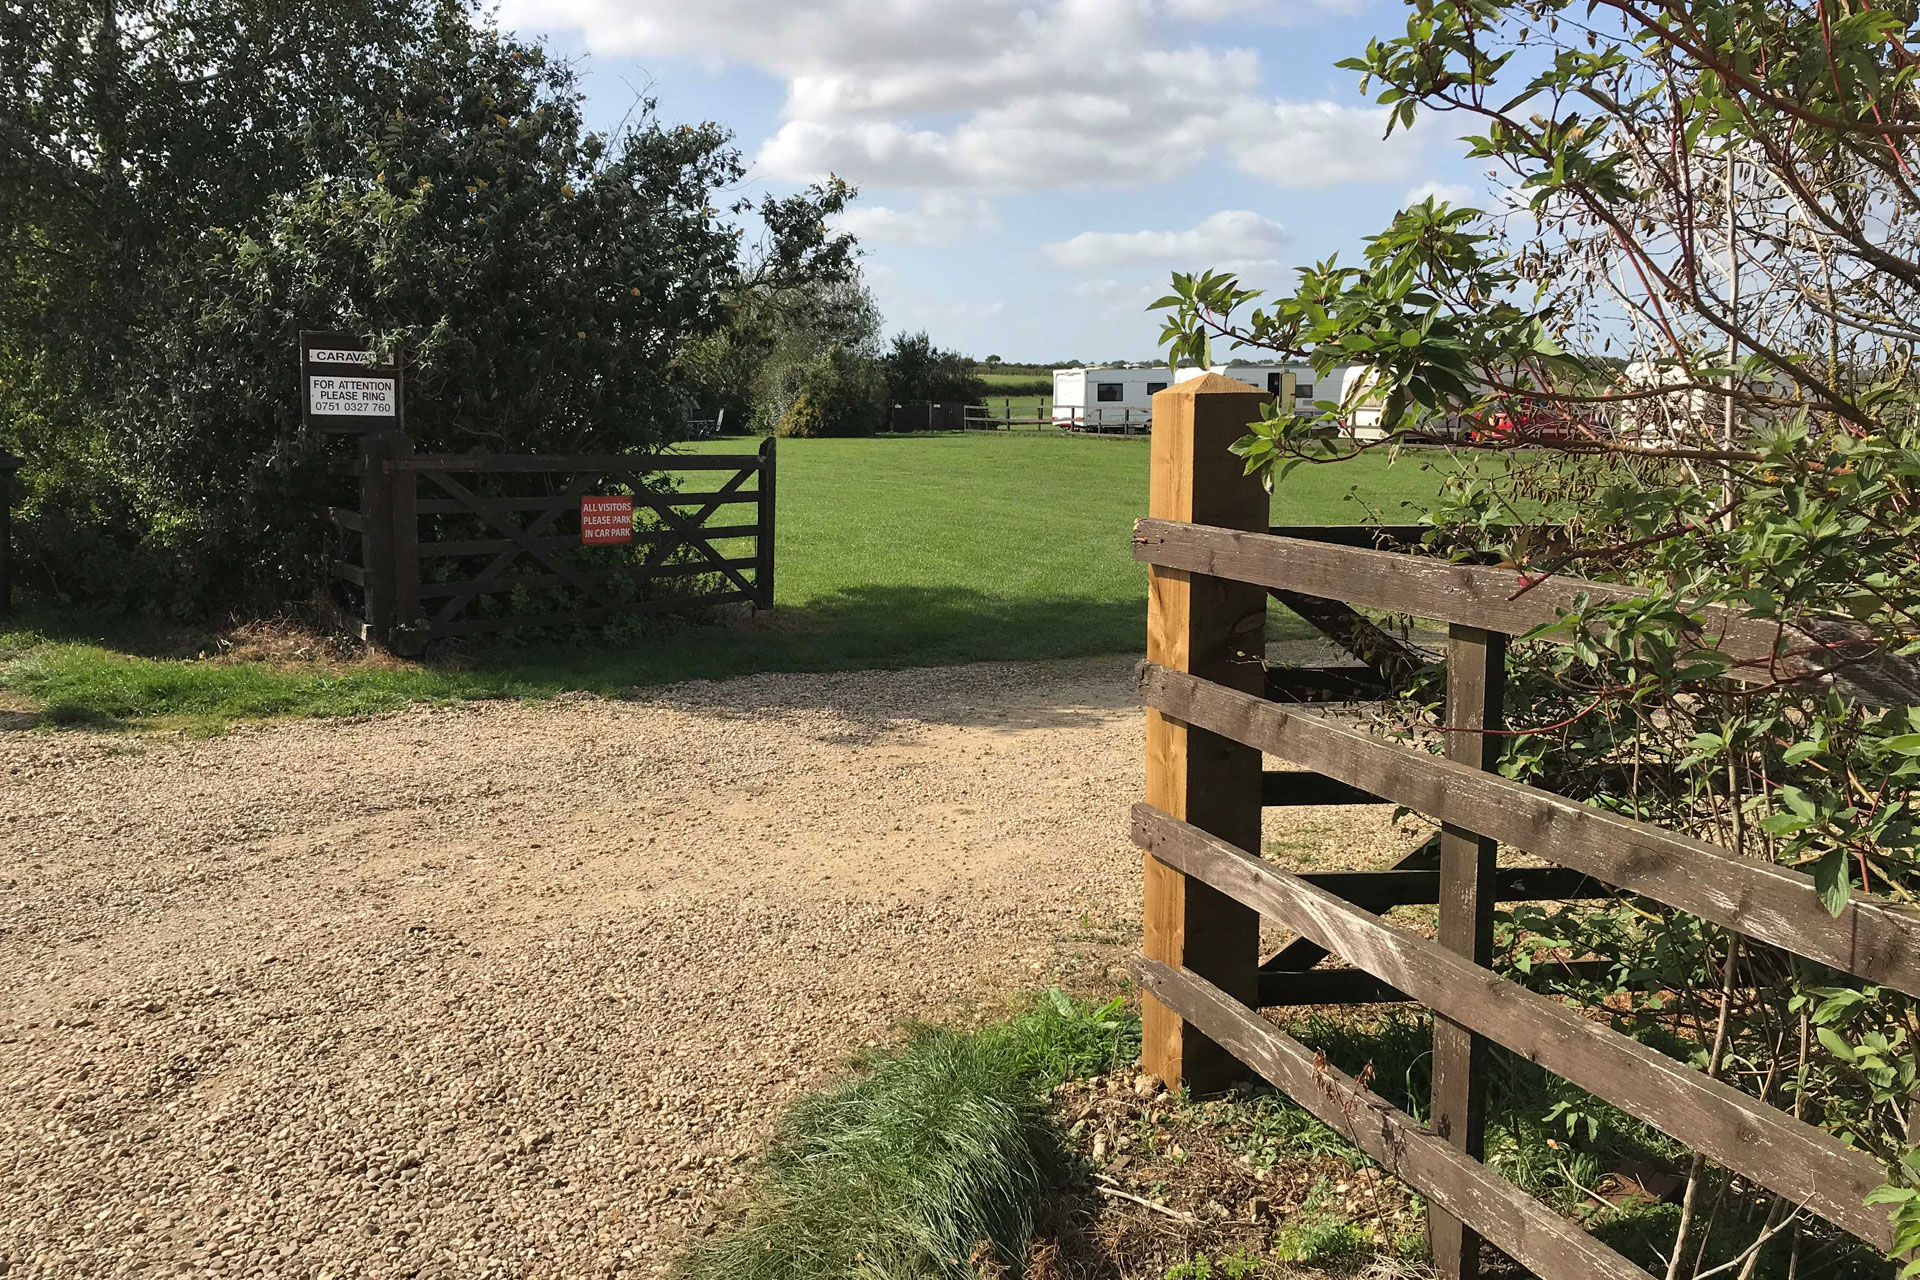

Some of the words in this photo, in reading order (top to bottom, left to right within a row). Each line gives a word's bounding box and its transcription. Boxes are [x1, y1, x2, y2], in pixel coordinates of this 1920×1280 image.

[316, 351, 386, 362] CARAVA
[313, 380, 334, 389] FOR
[338, 380, 392, 391] ATTENTION
[320, 391, 358, 400] PLEASE
[362, 392, 386, 401] RING
[315, 402, 340, 411] 0751
[344, 402, 369, 411] 0327
[372, 403, 391, 412] 760
[583, 503, 597, 512] ALL
[598, 503, 631, 511] VISITORS
[583, 516, 611, 525] PLEASE
[612, 515, 631, 524] PARK
[585, 529, 593, 538] IN
[594, 529, 610, 537] CAR
[611, 528, 630, 537] PARK
